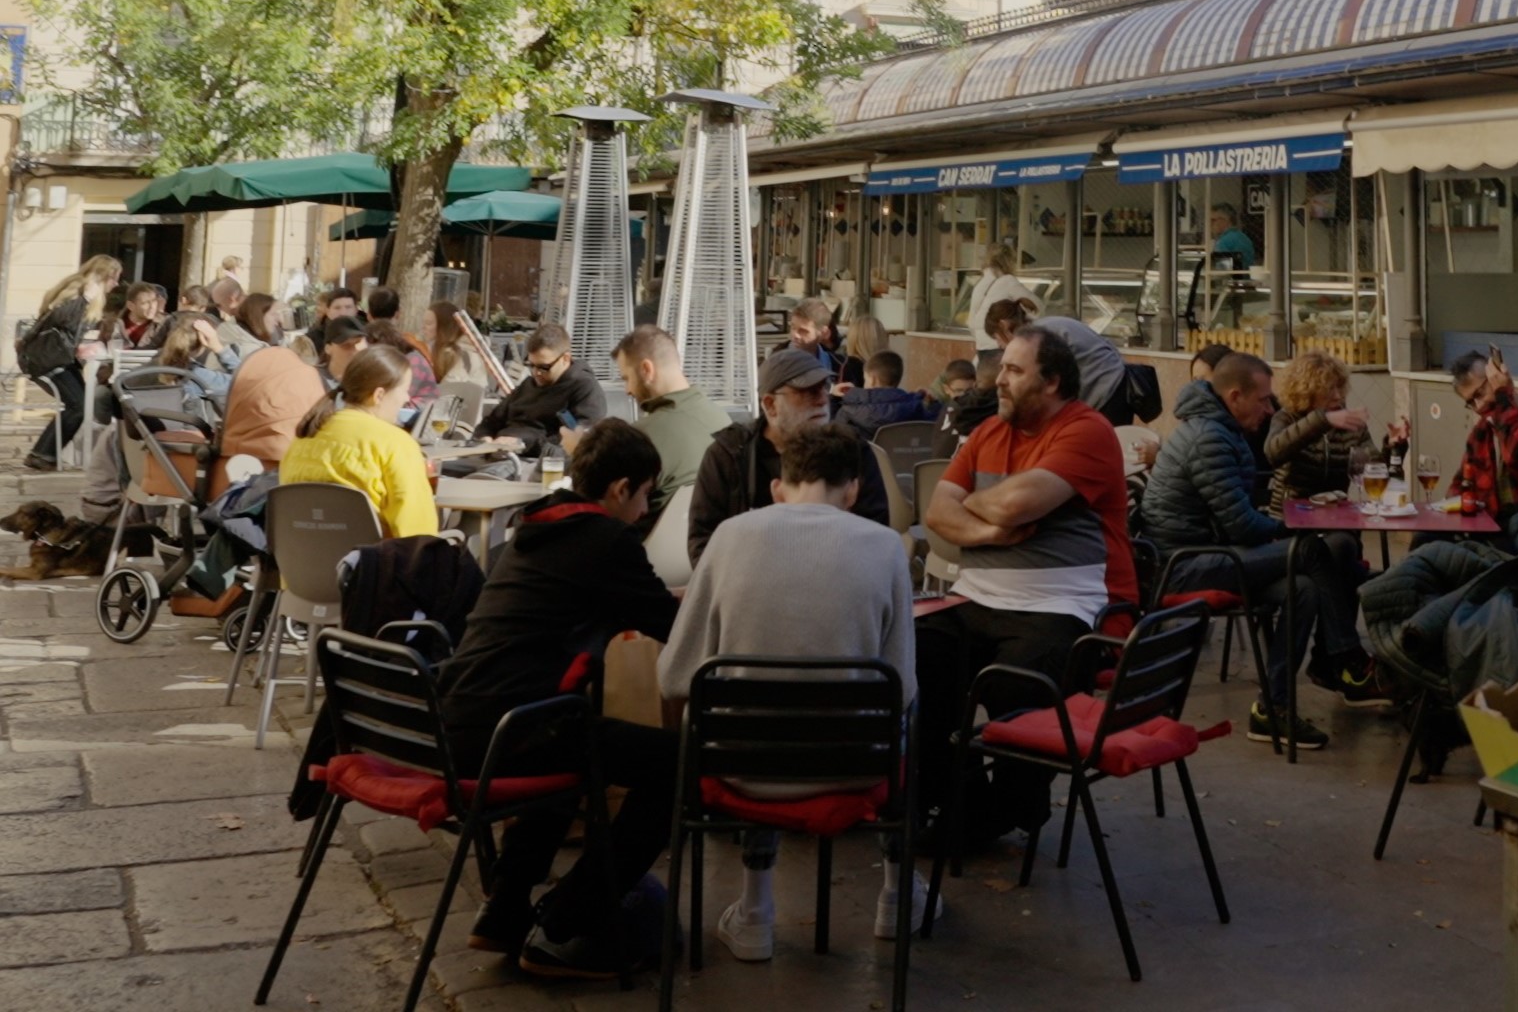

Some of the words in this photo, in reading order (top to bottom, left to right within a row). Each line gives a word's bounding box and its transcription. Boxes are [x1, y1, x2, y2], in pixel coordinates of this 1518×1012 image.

[1163, 153, 1180, 178] LA
[1183, 144, 1288, 176] POLLASTRERIA
[938, 167, 958, 188] CAN
[958, 164, 997, 185] SERRAT
